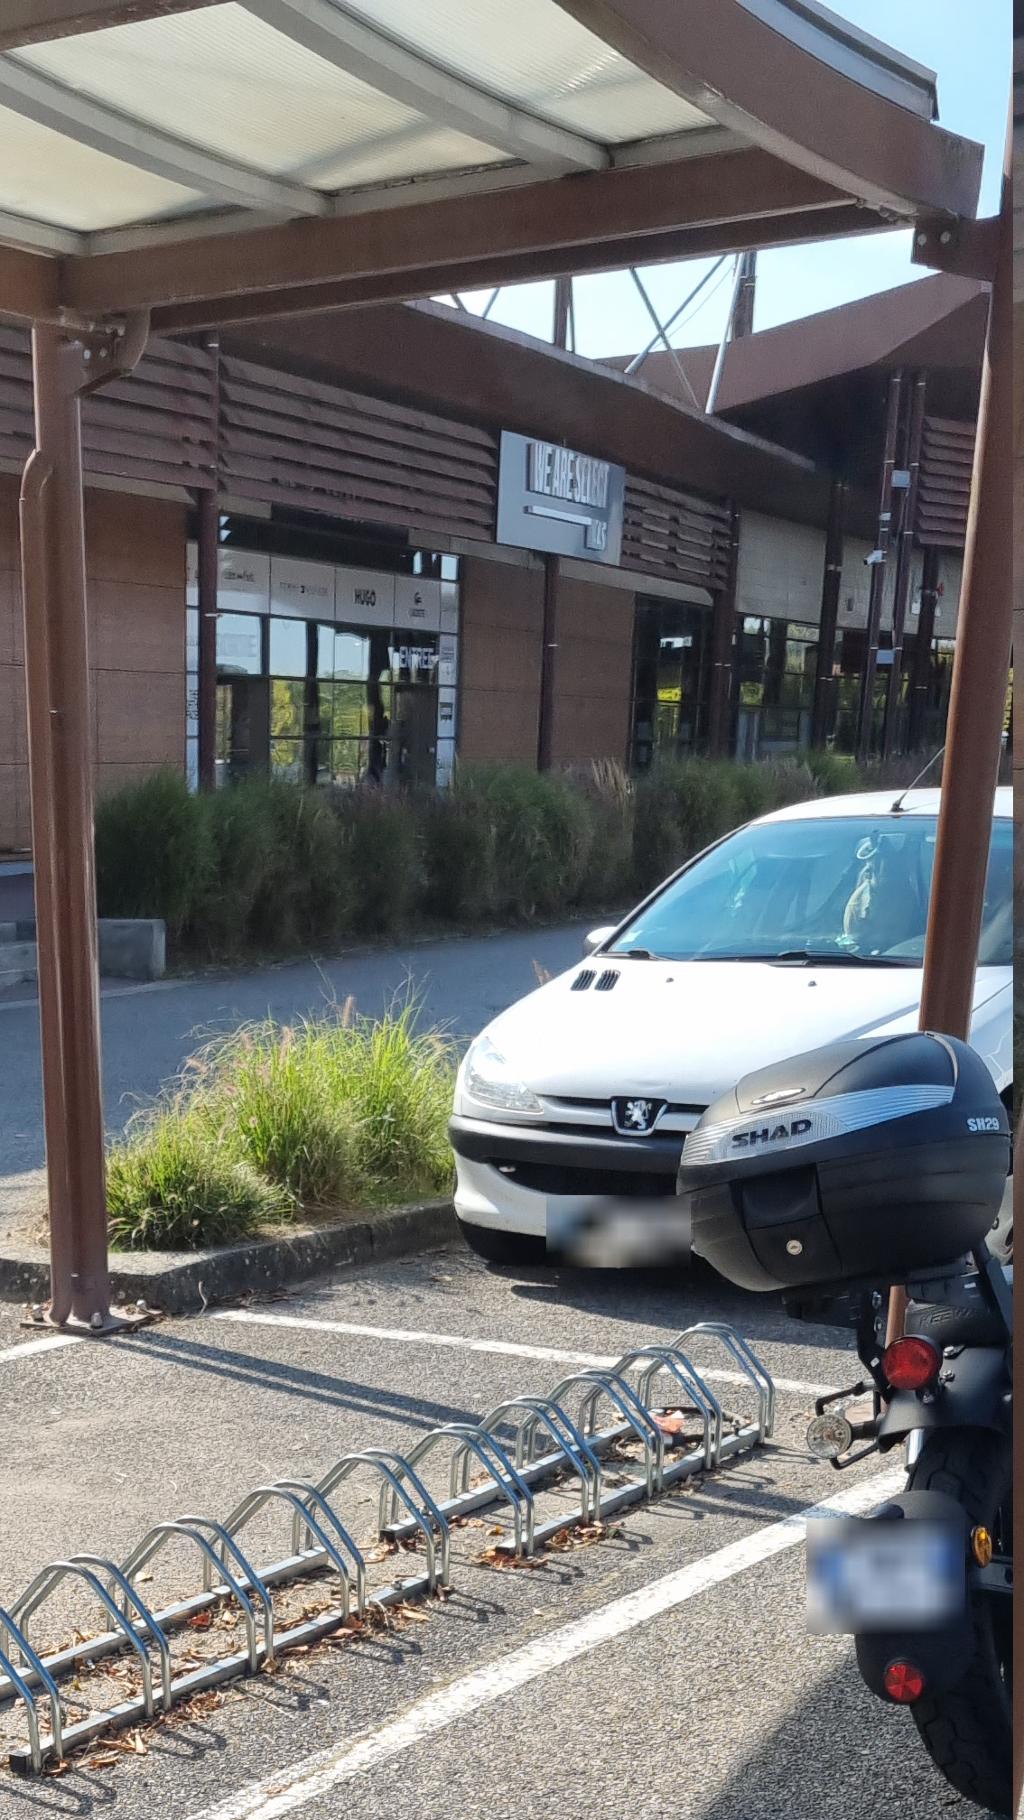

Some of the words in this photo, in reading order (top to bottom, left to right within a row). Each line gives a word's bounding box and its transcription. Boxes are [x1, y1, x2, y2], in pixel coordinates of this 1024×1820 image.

[354, 588, 377, 607] HUGO
[731, 1118, 813, 1149] SHAD
[966, 1117, 1000, 1132] SH29
